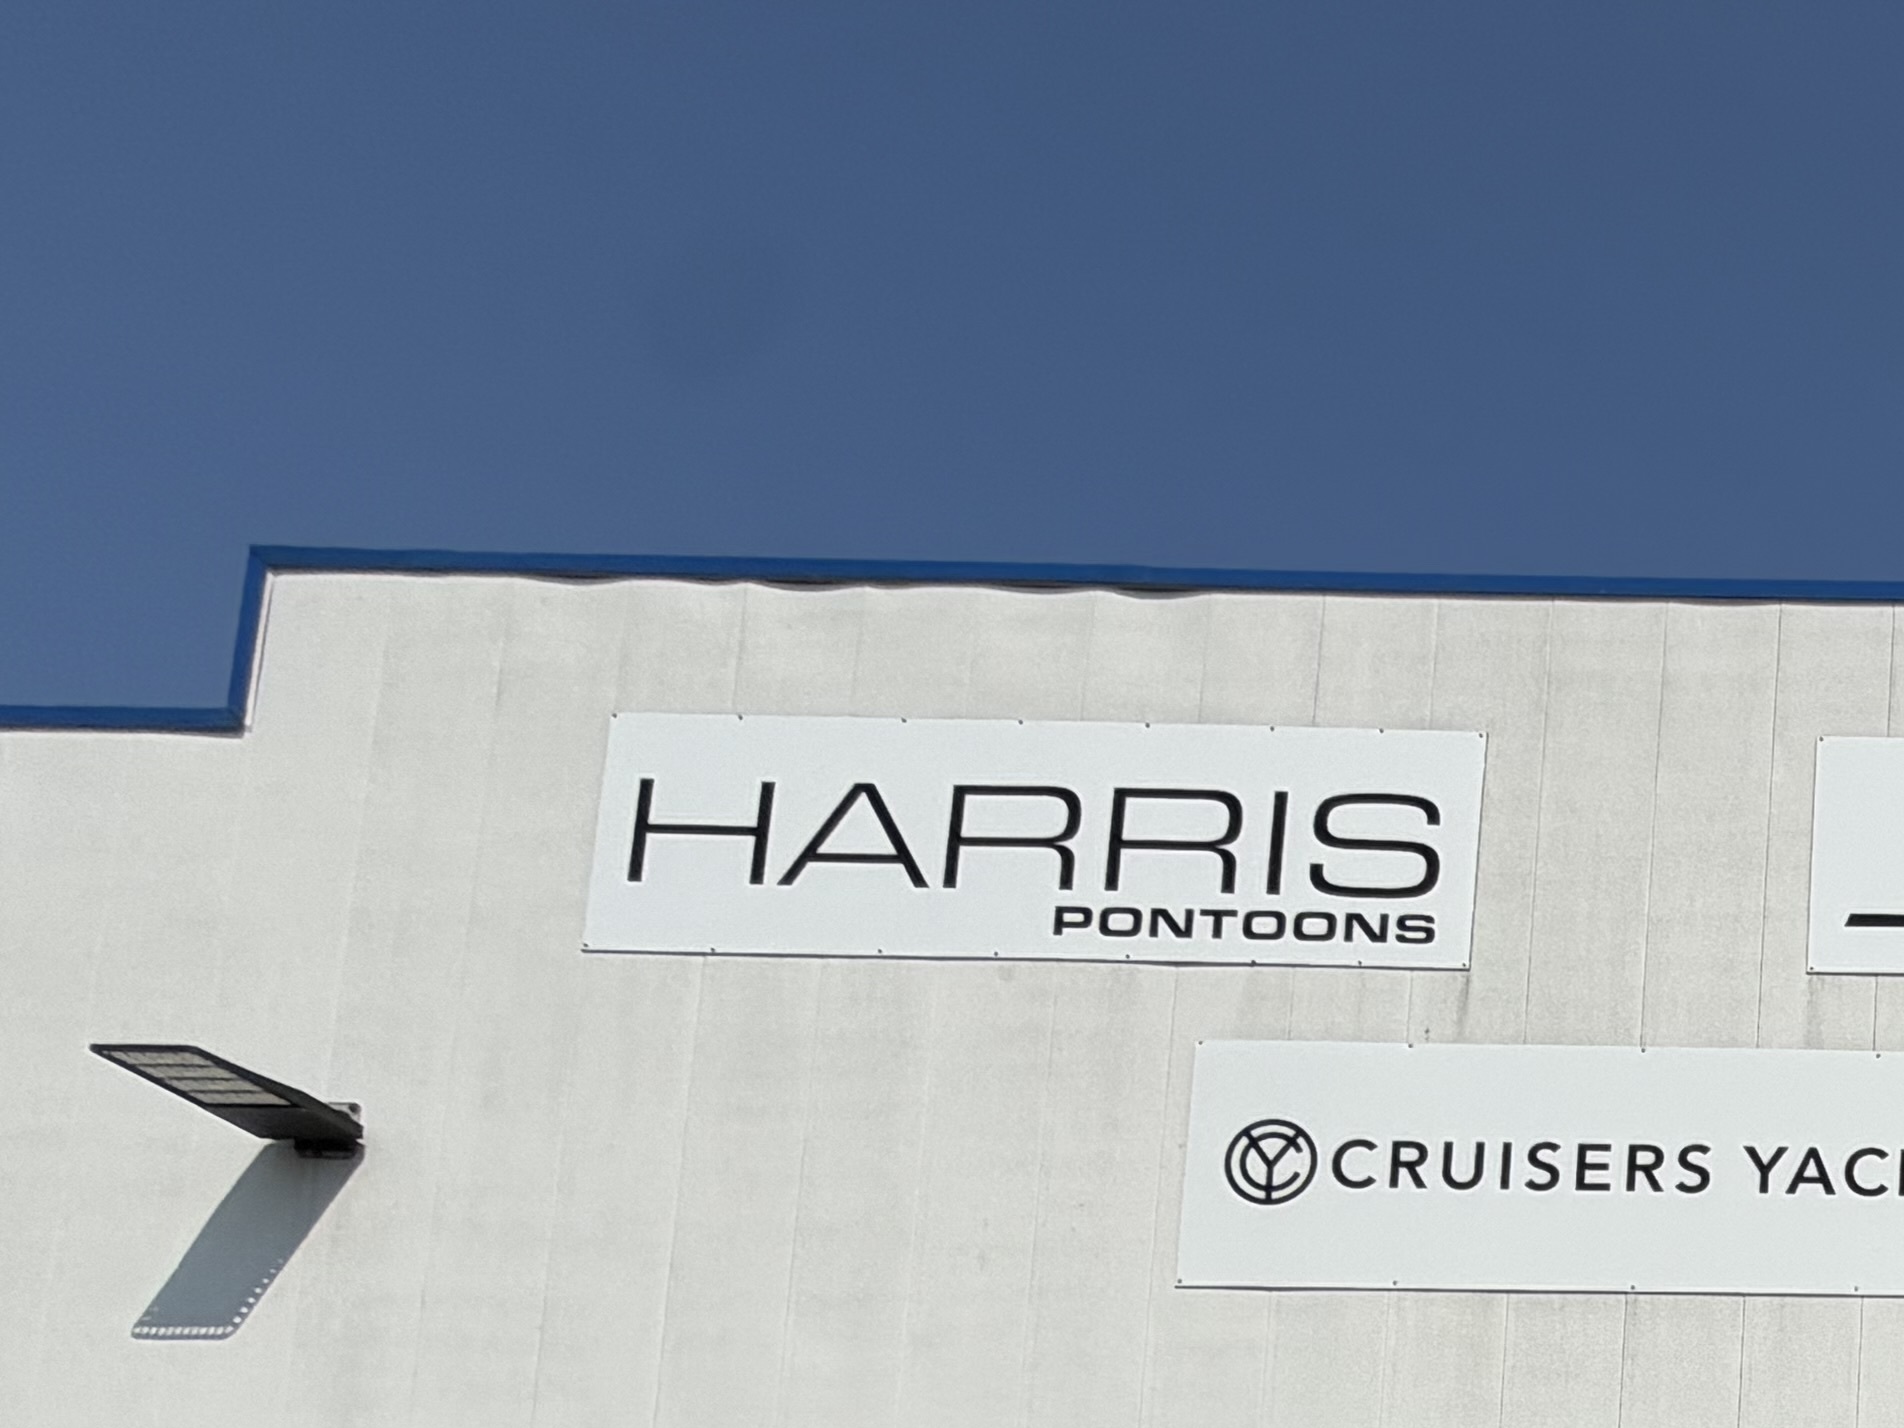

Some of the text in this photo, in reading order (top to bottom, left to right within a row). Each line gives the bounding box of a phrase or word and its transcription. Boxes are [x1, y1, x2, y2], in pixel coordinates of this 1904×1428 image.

[628, 778, 1441, 900] HARRIS
[1053, 905, 1436, 945] PONTOONS
[1330, 1138, 1712, 1195] CRUISERS
